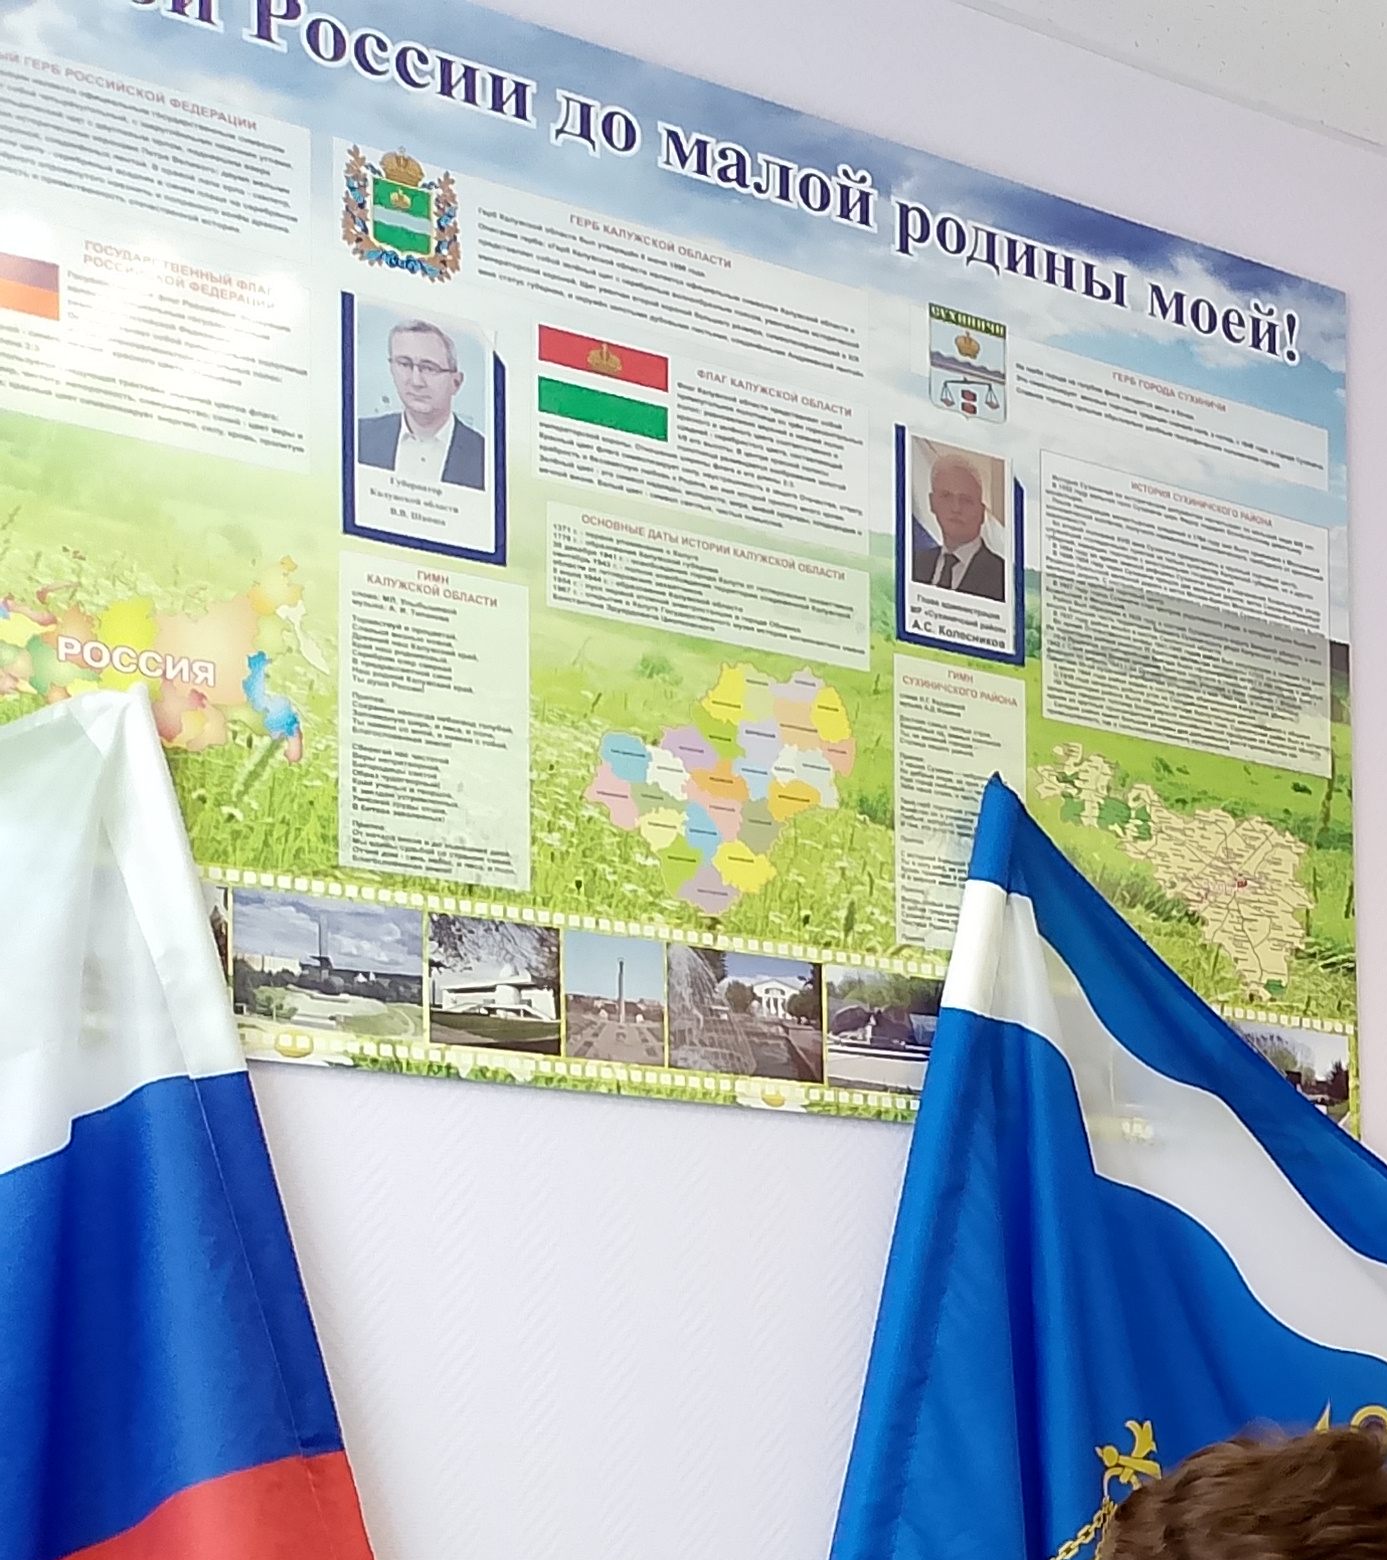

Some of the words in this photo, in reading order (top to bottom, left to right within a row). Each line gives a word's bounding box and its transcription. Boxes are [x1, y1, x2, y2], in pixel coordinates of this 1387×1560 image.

[65, 67, 166, 105] РОССИЙСКОЙ
[169, 97, 257, 130] ФЕДЕРАЦИИ
[555, 96, 637, 152] до
[663, 127, 874, 227] малой
[895, 200, 1127, 308] родины
[1148, 283, 1297, 361] моей!
[570, 214, 599, 231] ГЕРБ
[603, 224, 675, 251] КАЛУЖСКОЙ
[678, 245, 732, 268] ОБЛАСТИ
[697, 369, 727, 384] ФЛАГ
[730, 376, 799, 403] КАЛУЖСКОЙ
[802, 393, 852, 417] ОБЛАСТИ
[581, 514, 645, 537] ОСНОВНЫЕ
[647, 528, 679, 544] ДАТЫ
[681, 536, 730, 556] ИСТОРИИ
[733, 547, 796, 570] КАЛУЖСКОЙ
[798, 561, 845, 581] ОБЛАСТИ
[367, 574, 440, 597] КАЛУЖСКОЙ
[443, 585, 498, 608] ОБЛАСТИ
[417, 570, 450, 585] ГИМН
[57, 635, 217, 688] РОССИЯ
